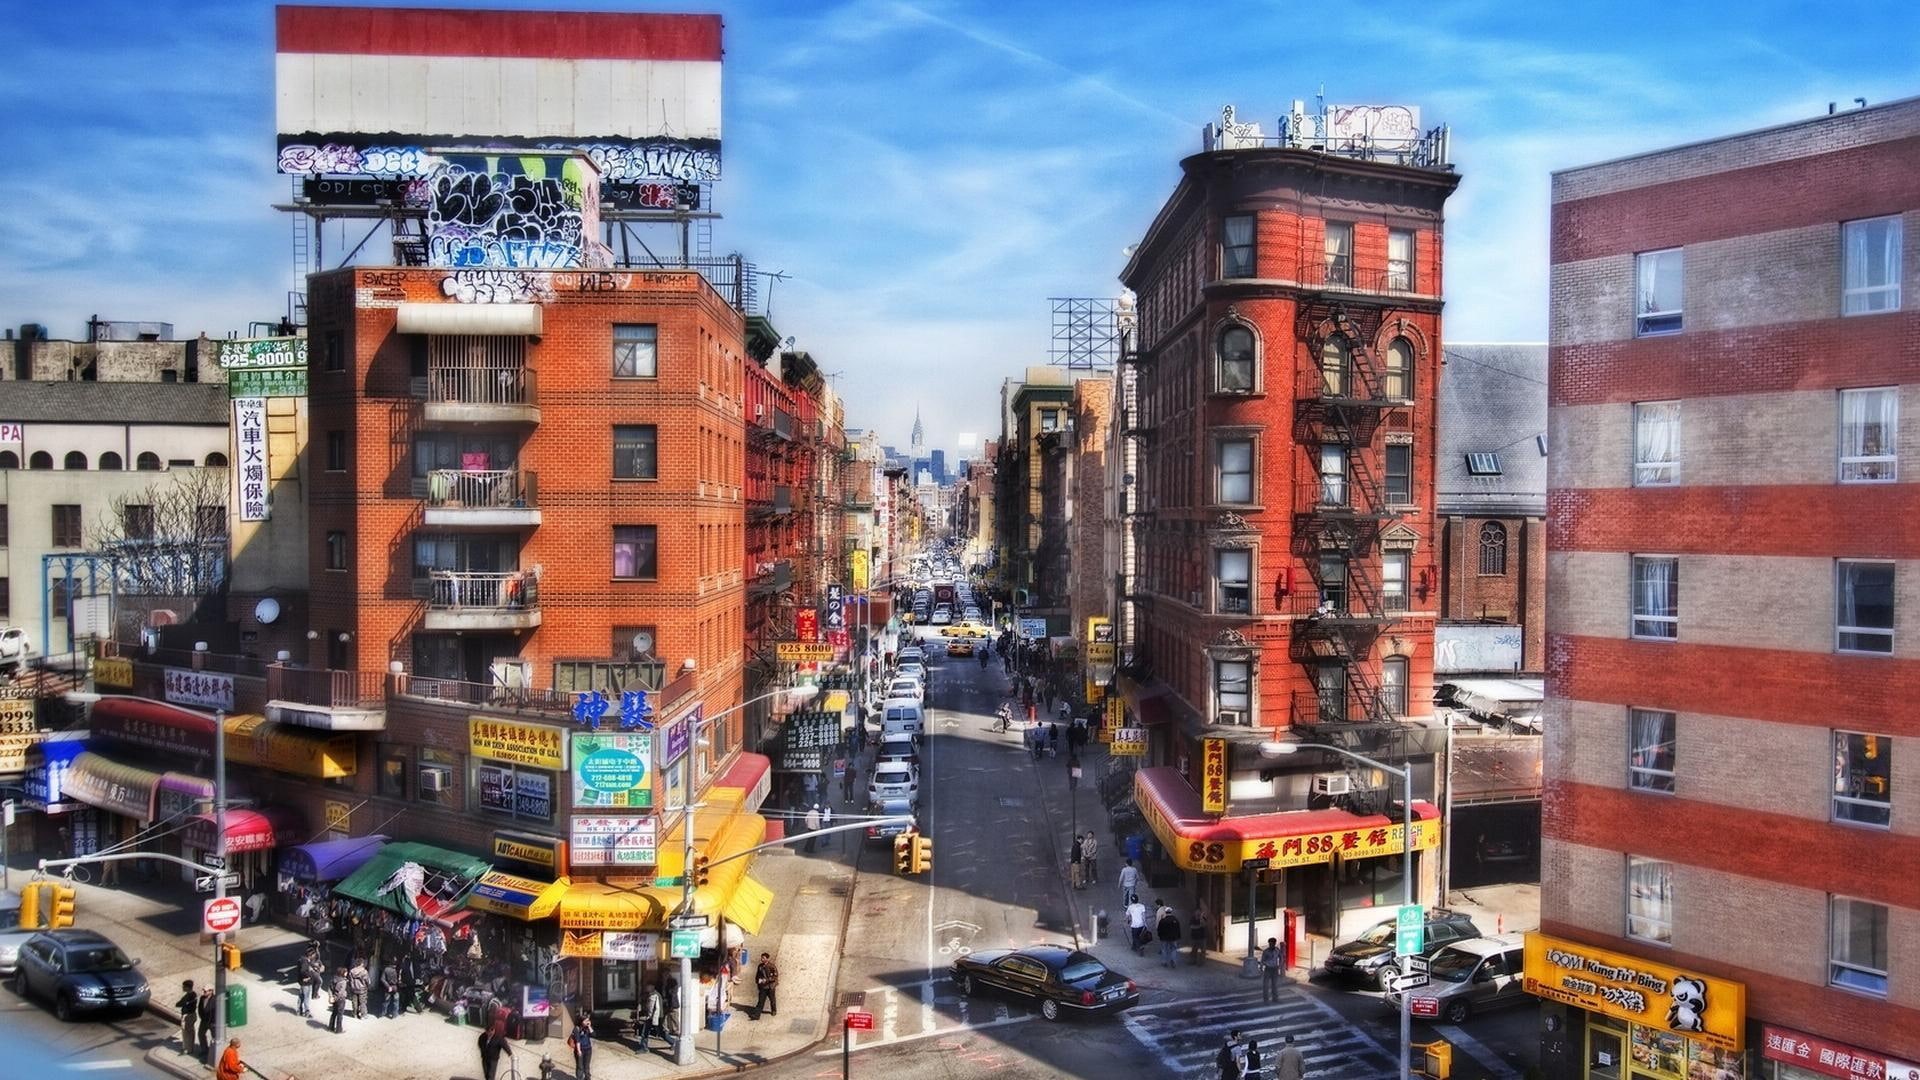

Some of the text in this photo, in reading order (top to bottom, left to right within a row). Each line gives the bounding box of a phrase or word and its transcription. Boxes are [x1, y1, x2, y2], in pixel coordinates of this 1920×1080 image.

[220, 352, 294, 367] 925-8000
[780, 643, 832, 653] 925 8000
[1189, 841, 1225, 864] 88
[1587, 961, 1615, 980] Kung
[1616, 968, 1630, 981] Fu
[1637, 973, 1664, 991] Bing
[1766, 1033, 1812, 1059] 速匯金
[1819, 1047, 1883, 1080] 國際匯款
